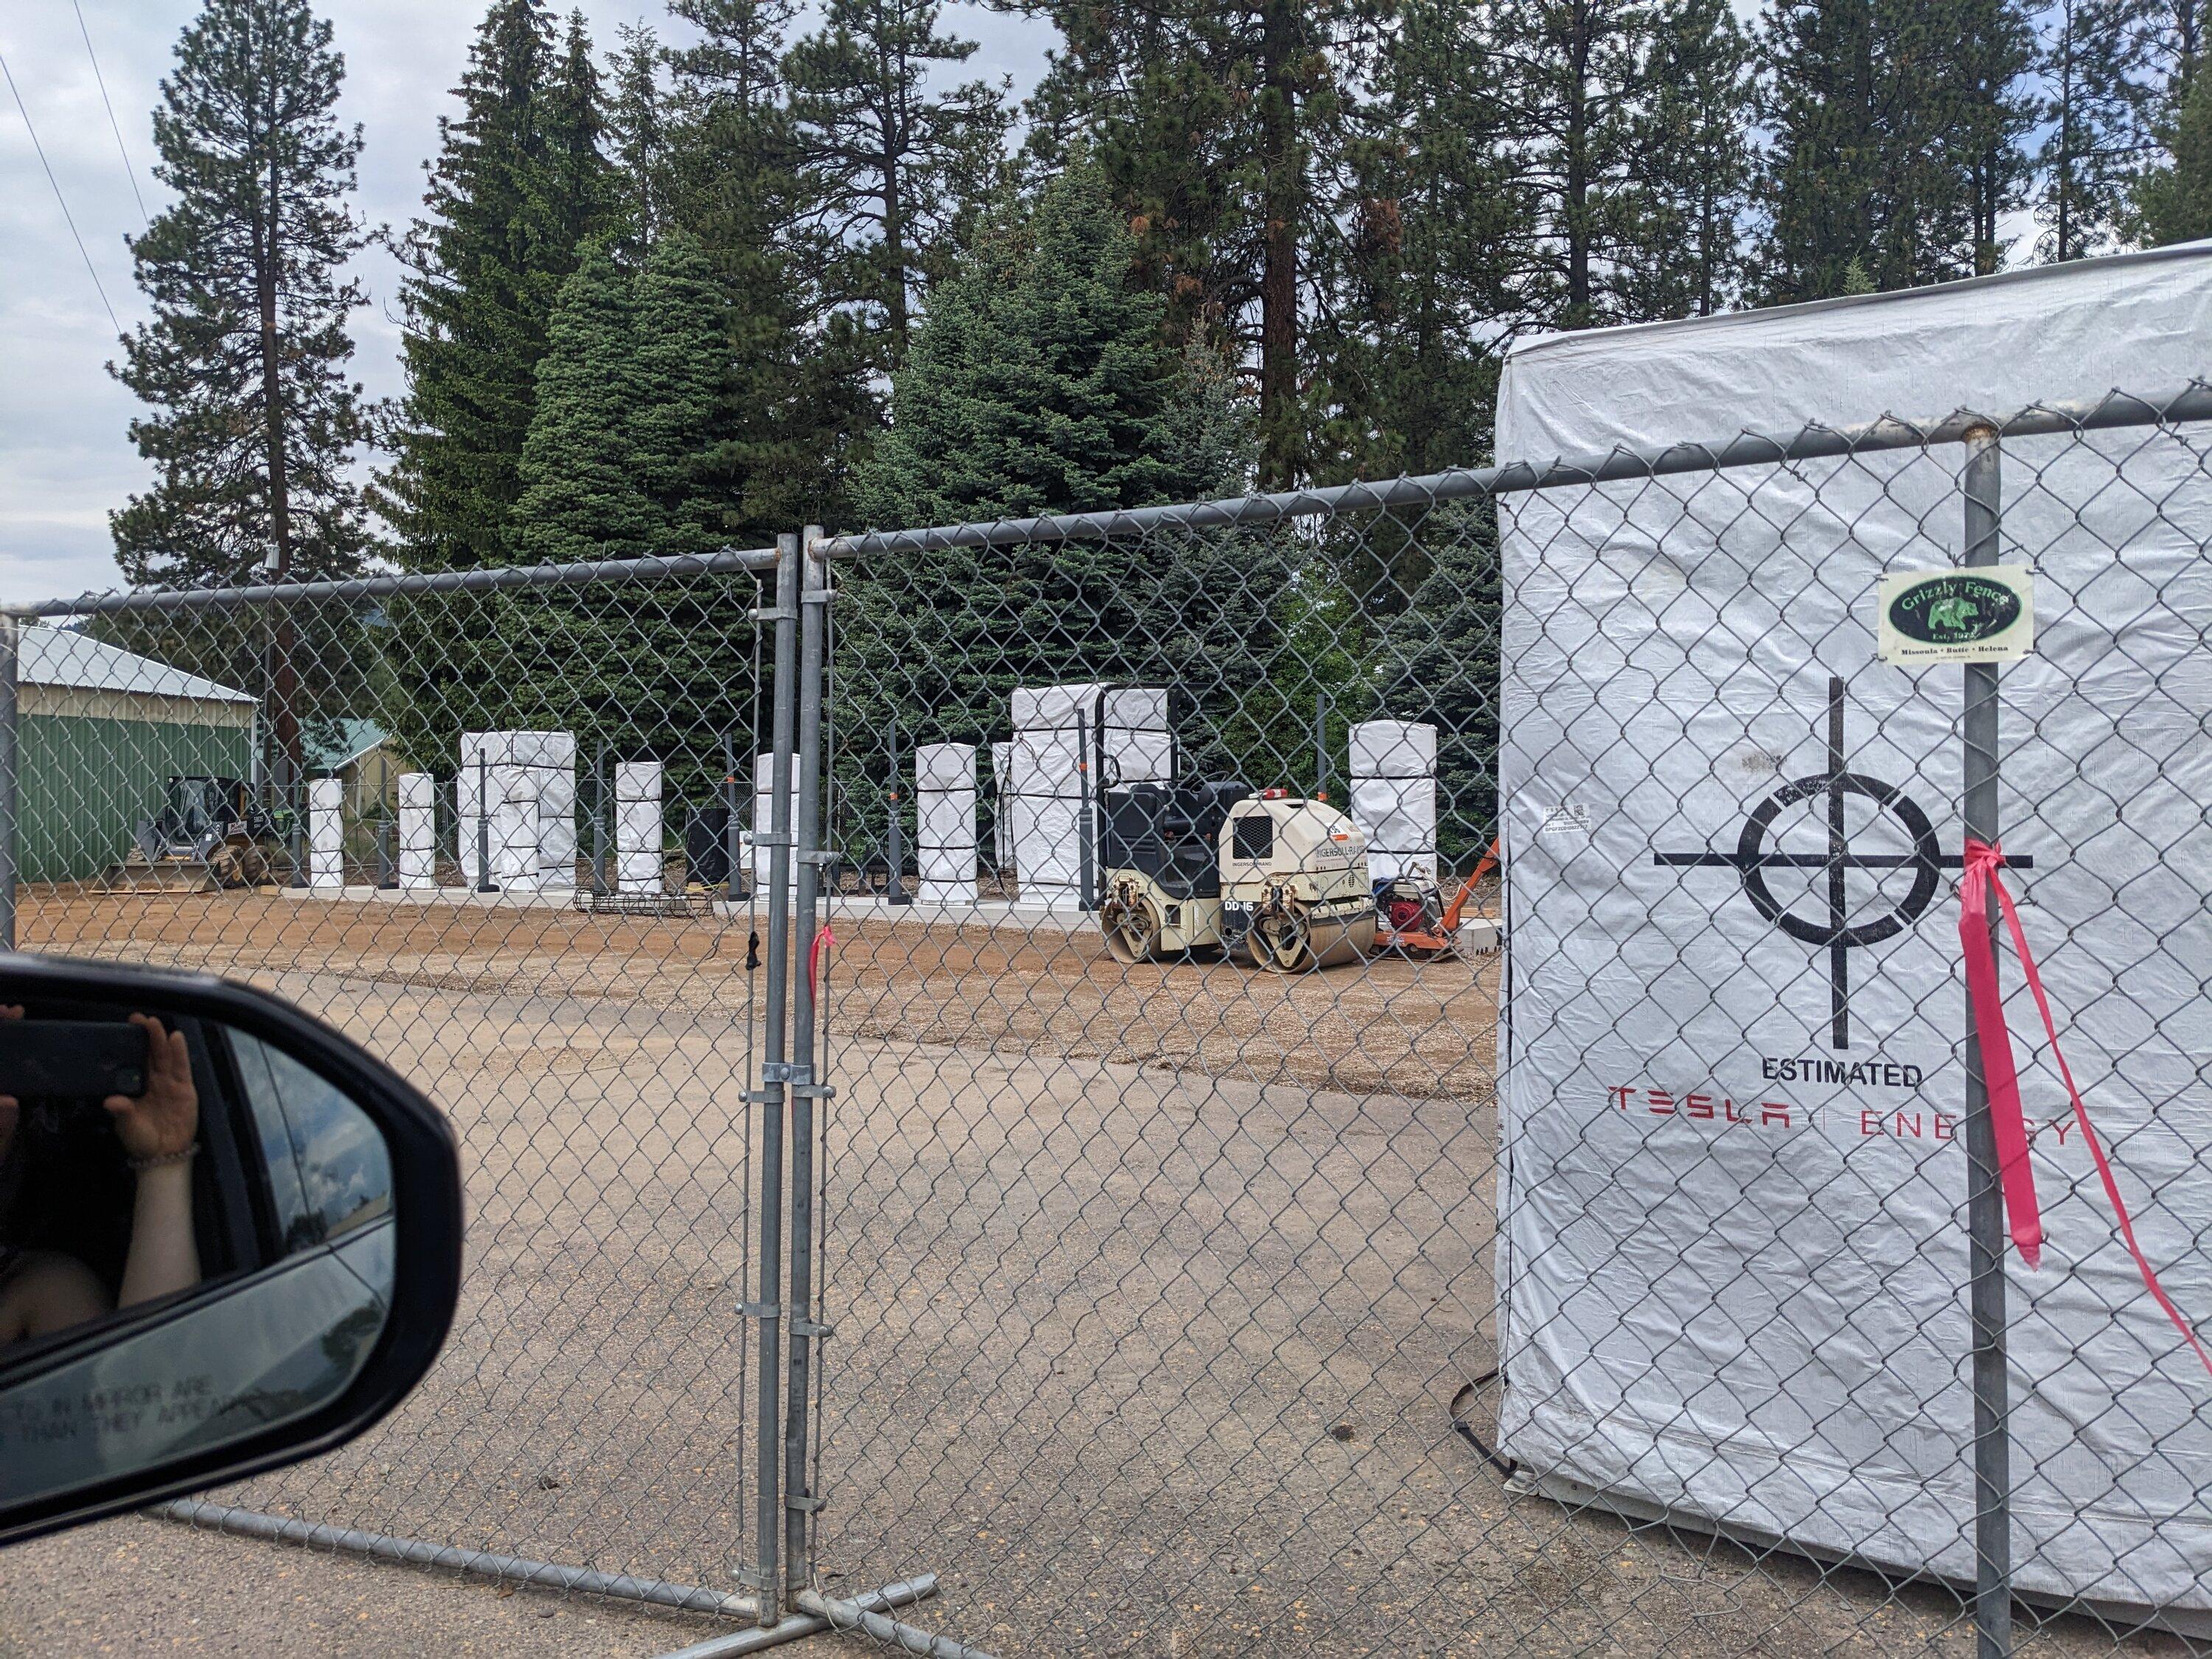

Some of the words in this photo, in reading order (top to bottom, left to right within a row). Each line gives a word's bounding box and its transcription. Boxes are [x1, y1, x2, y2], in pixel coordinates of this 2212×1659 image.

[1902, 581, 1957, 610] Grizzly
[1965, 581, 2009, 605] Fence
[1762, 1057, 1922, 1088] ESTIMATED
[1607, 1085, 1790, 1128] TESLA
[1861, 1110, 2076, 1146] ENEY
